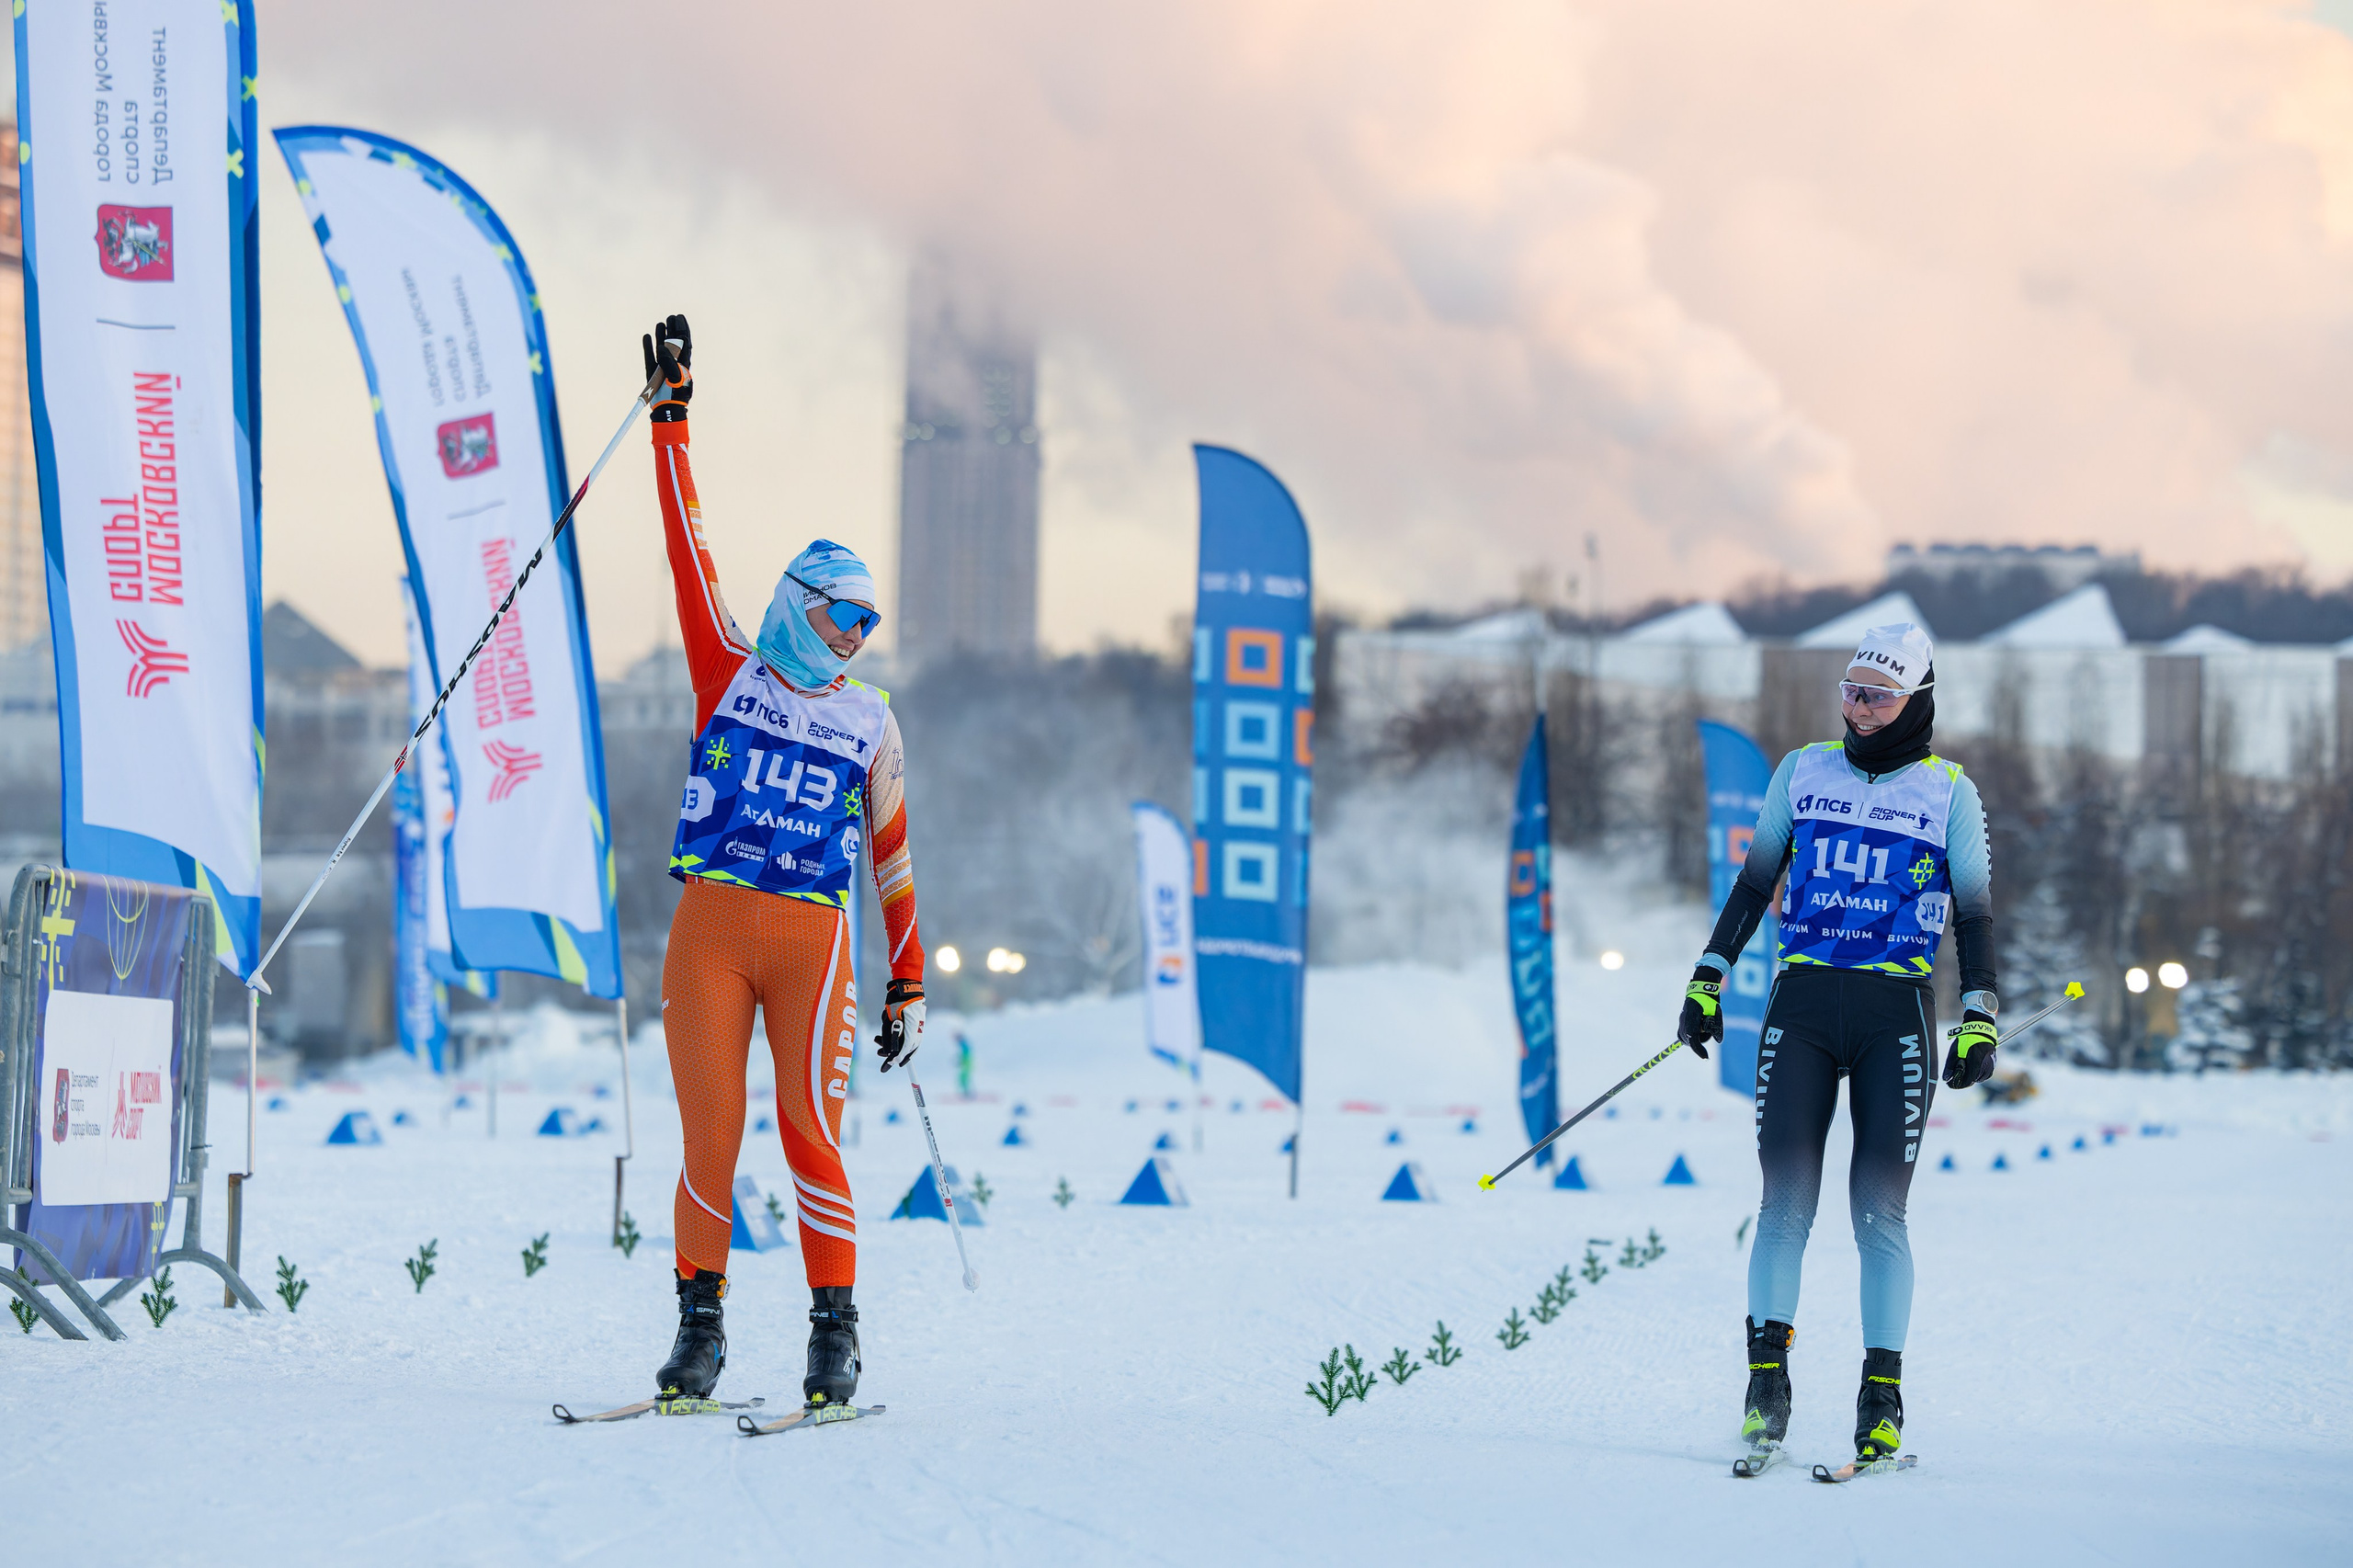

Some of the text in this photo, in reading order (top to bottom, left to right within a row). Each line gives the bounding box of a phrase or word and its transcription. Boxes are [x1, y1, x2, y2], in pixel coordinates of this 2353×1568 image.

[1857, 651, 1905, 676] VIUM
[756, 702, 790, 729] ПСБ
[807, 728, 833, 741] CUP
[809, 721, 855, 743] PIONER
[741, 748, 837, 812] 143
[1814, 798, 1853, 814] ПСБ
[1871, 806, 1916, 821] PIONER
[1868, 812, 1894, 822] CUP
[737, 842, 767, 856] ГАЗПРОМ
[1813, 837, 1890, 885] 141
[800, 867, 824, 877] ГОРОДА
[1811, 890, 1888, 913] АТАМАН
[1921, 902, 1945, 925] 141
[1822, 927, 1872, 941] BIVIUM
[1898, 1034, 1923, 1163] BIVIUM
[696, 1306, 721, 1315] SPIN
[670, 1398, 721, 1415] FISCHER
[823, 1405, 858, 1422] FISCHER
